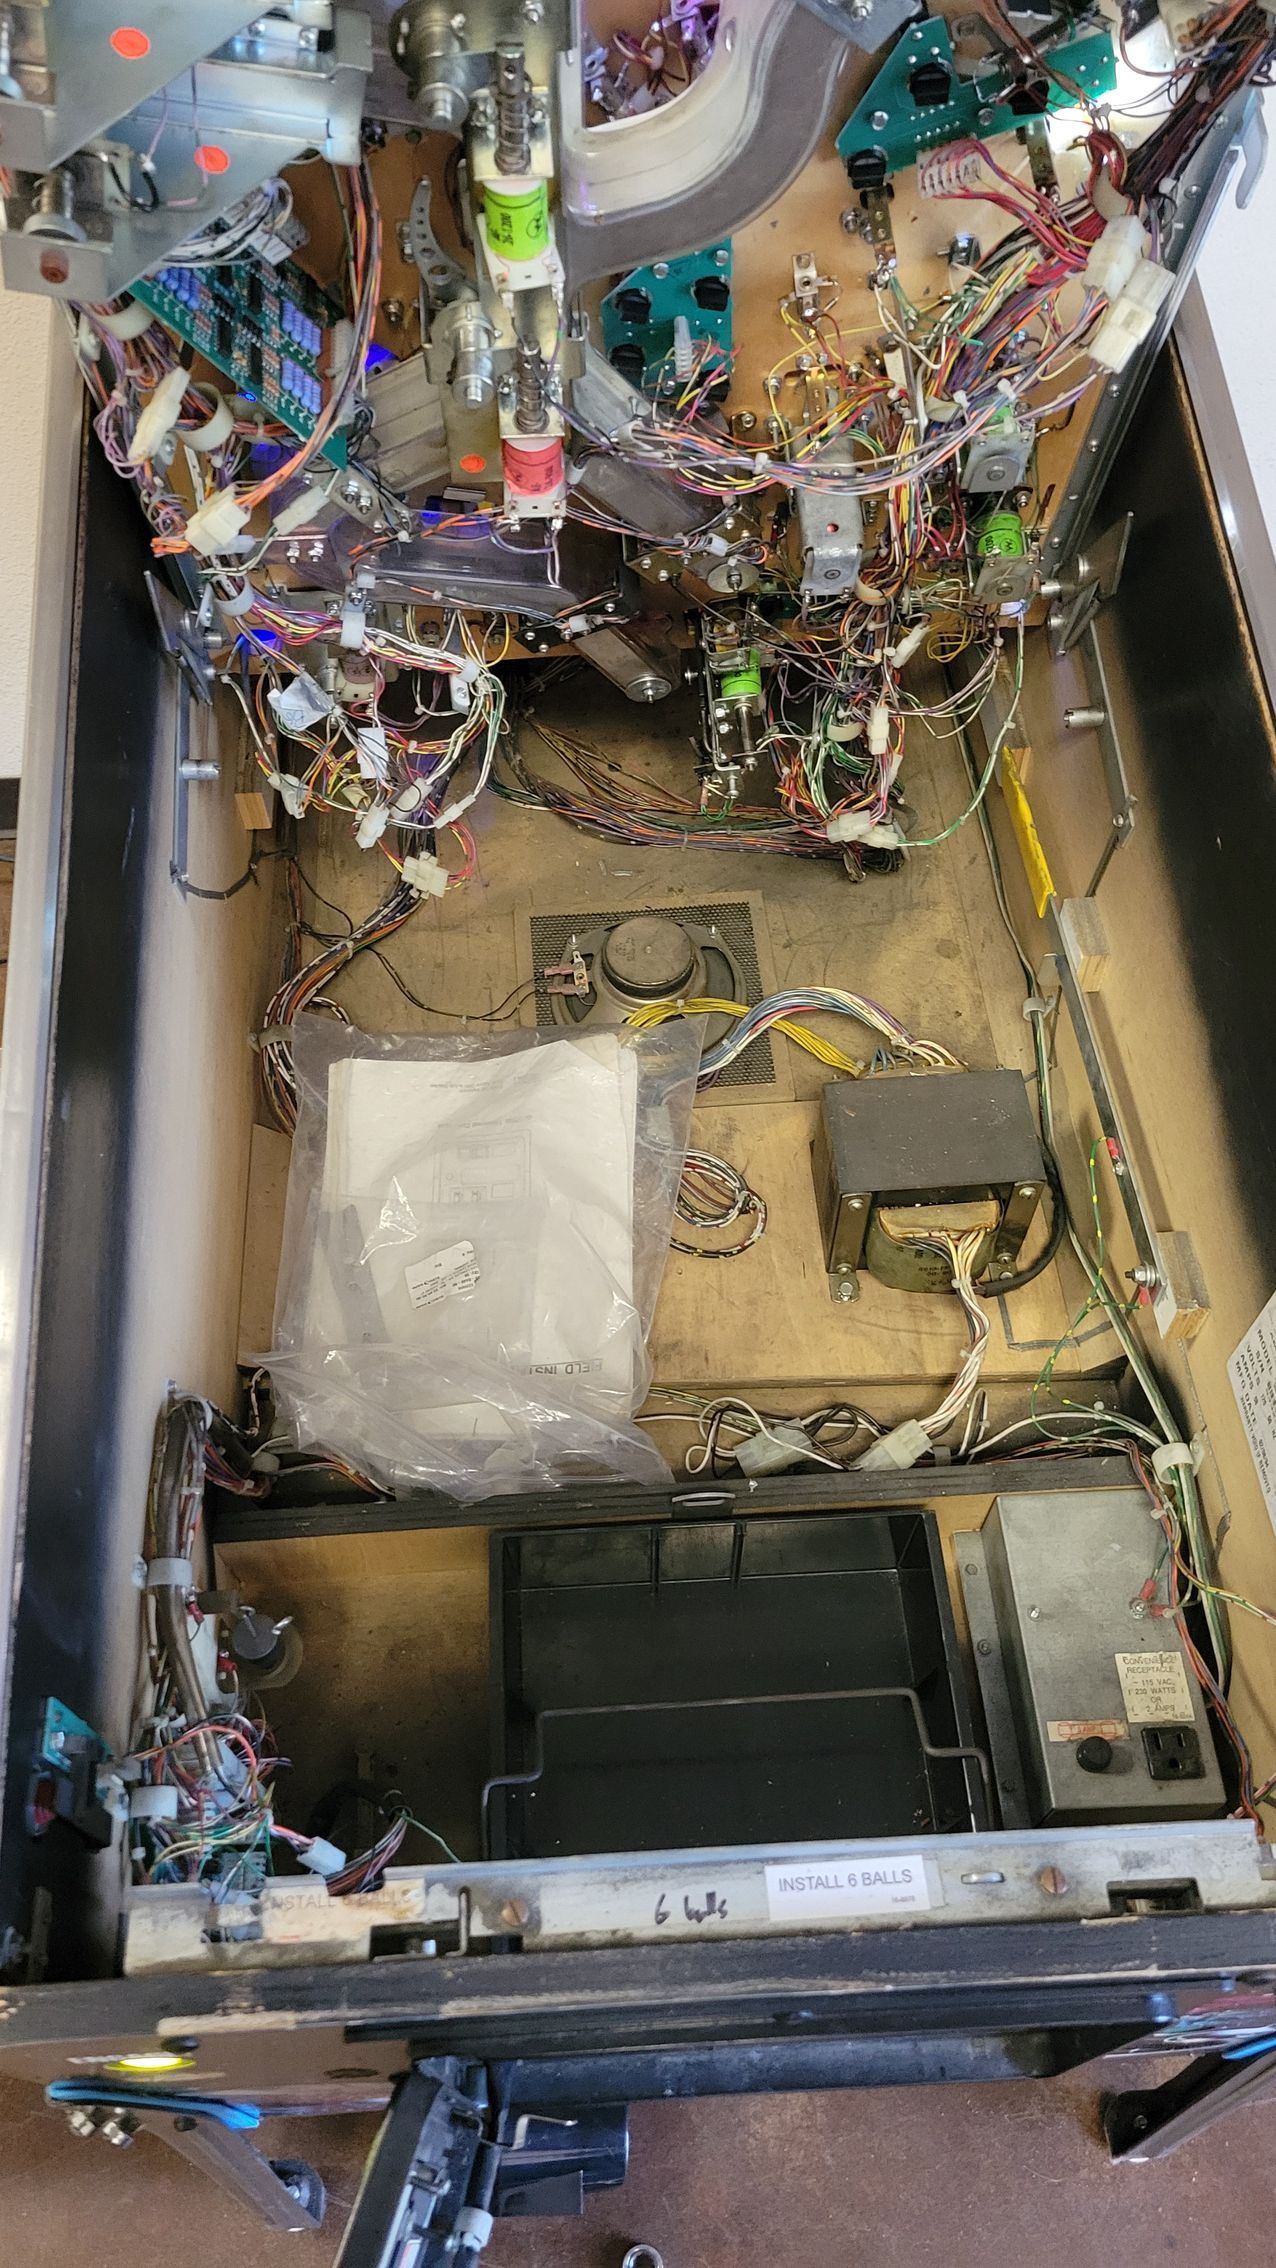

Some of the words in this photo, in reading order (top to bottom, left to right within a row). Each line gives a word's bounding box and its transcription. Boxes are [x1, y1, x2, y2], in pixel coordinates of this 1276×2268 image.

[1246, 1344, 1261, 1387] VOLTS
[1256, 1328, 1273, 1376] MODEL
[779, 1875, 844, 1892] INSTALL
[848, 1873, 857, 1887] 6
[861, 1869, 913, 1887] BALLS
[654, 1893, 671, 1925] 6
